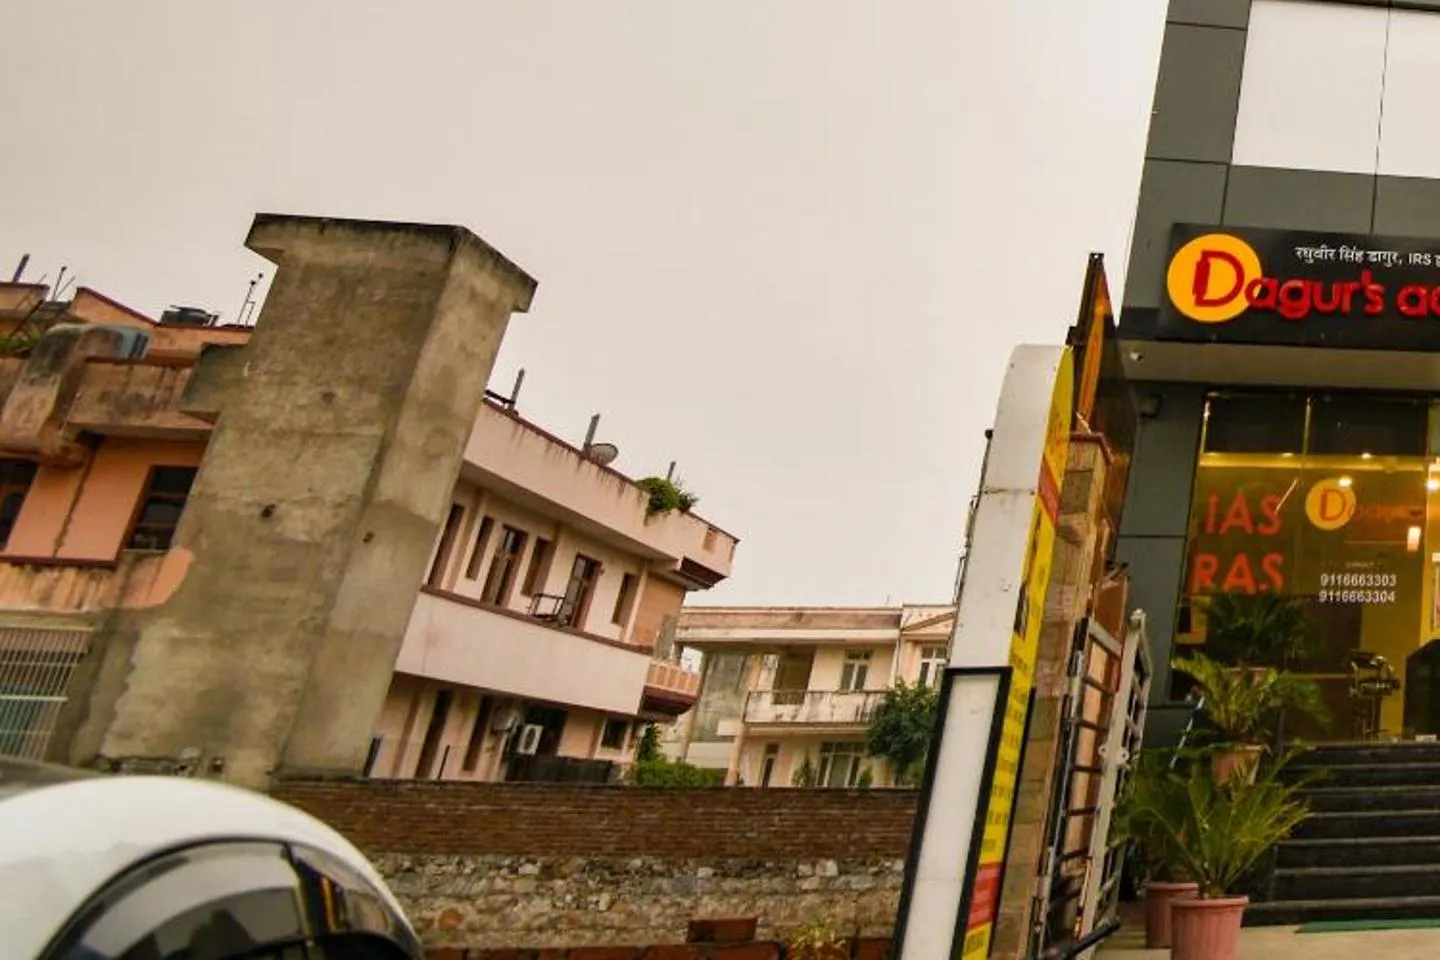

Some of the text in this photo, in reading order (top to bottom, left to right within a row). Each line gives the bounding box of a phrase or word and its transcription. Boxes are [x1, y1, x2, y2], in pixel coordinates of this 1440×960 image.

[1339, 244, 1364, 263] सिंह
[1408, 251, 1432, 266] IRS
[1193, 250, 1384, 321] Dagur's
[1205, 491, 1283, 535] IAS
[1192, 551, 1284, 594] RAS
